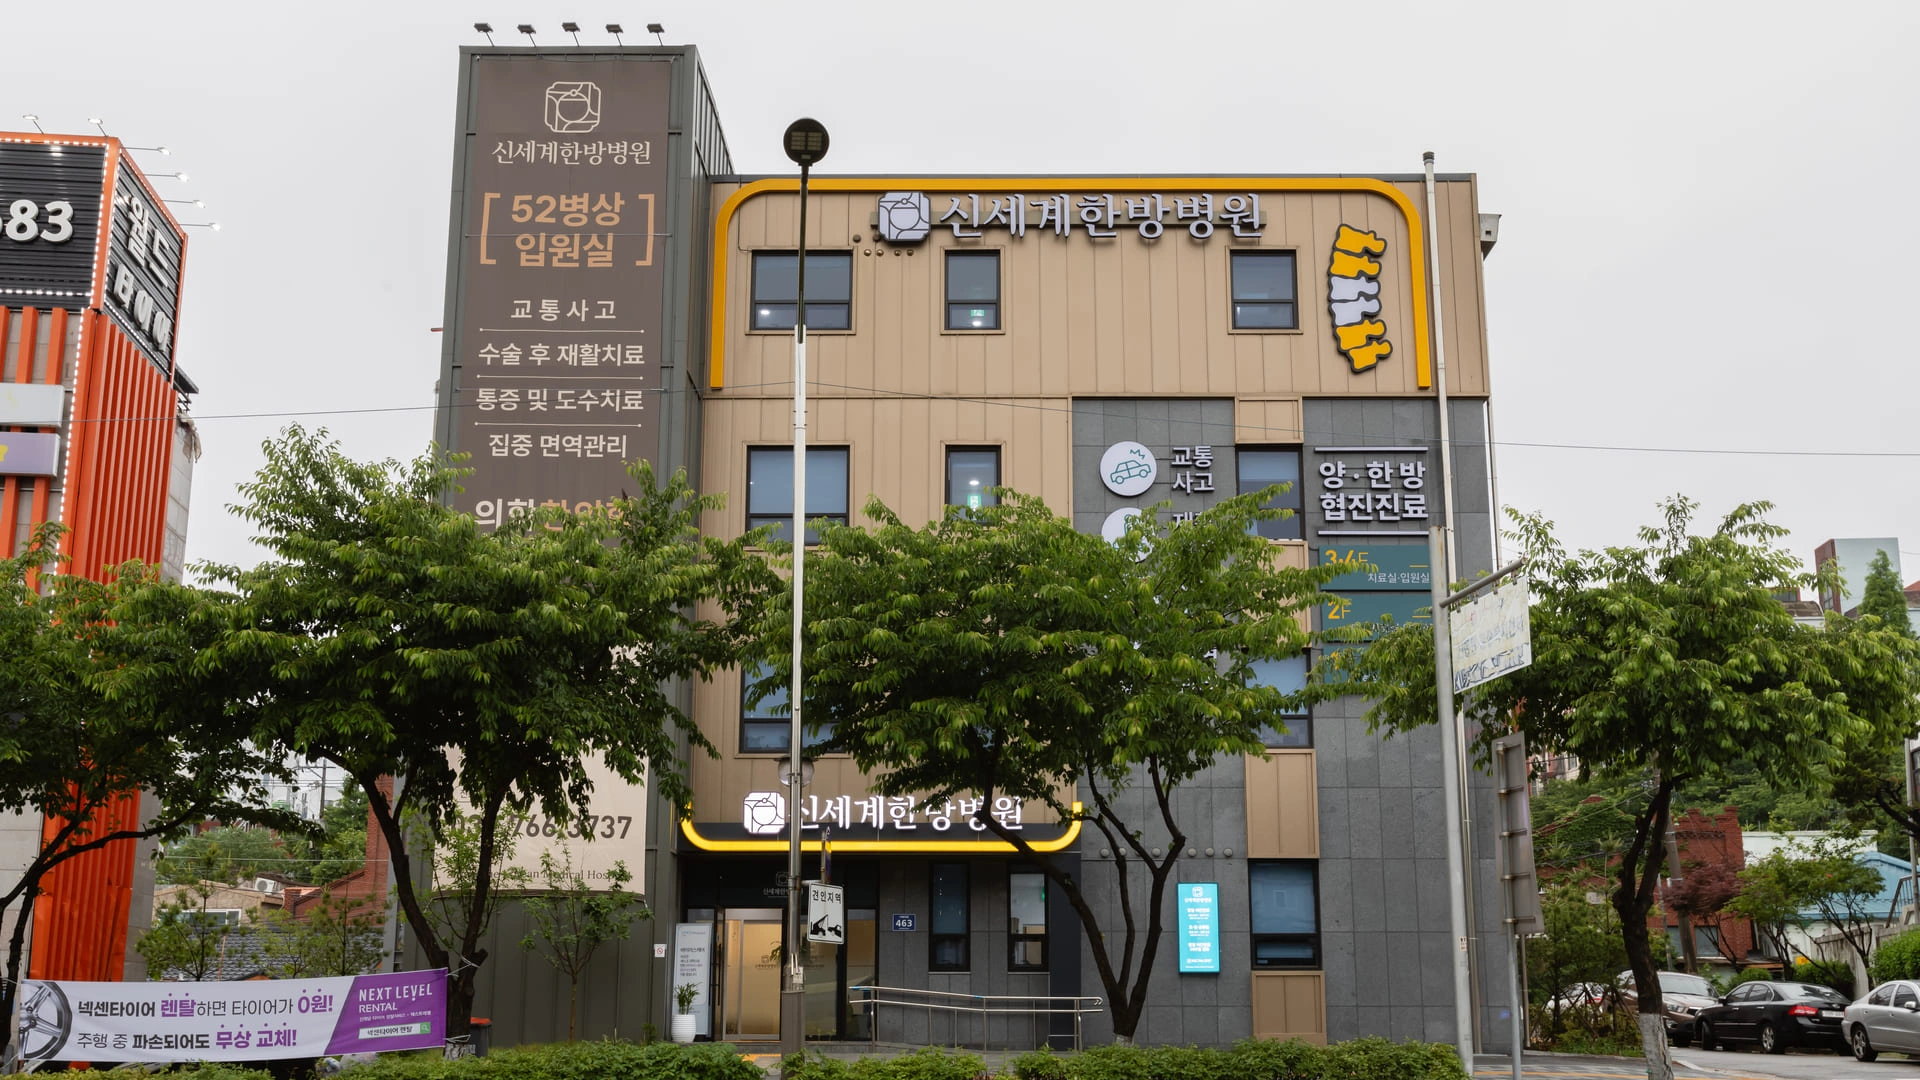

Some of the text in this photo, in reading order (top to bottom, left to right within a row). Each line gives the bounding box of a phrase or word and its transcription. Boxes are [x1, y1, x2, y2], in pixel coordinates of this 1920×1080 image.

[491, 140, 651, 165] 신세계한방병원
[0, 199, 74, 242] 83
[511, 192, 625, 227] 52병상
[940, 193, 1263, 239] 신세계한방병원
[514, 232, 614, 268] 입원실
[478, 343, 645, 367] 수술 후 재활치료
[476, 387, 644, 412] 통증 및 도수치료
[488, 434, 627, 458] 집중 면역관리
[1171, 445, 1214, 468] 교통
[1172, 471, 1215, 494] 사고
[1319, 492, 1429, 521] 협진진료
[812, 889, 842, 904] 견인지역
[895, 919, 913, 928] 463
[359, 984, 433, 1002] NEXT LEVEL
[78, 994, 334, 1017] 넥센타이어 렌탈하면 타이어가 0원!
[359, 1002, 398, 1013] RENTAL
[77, 1028, 297, 1050] 주행 중 파손되어도 무상 교체!
